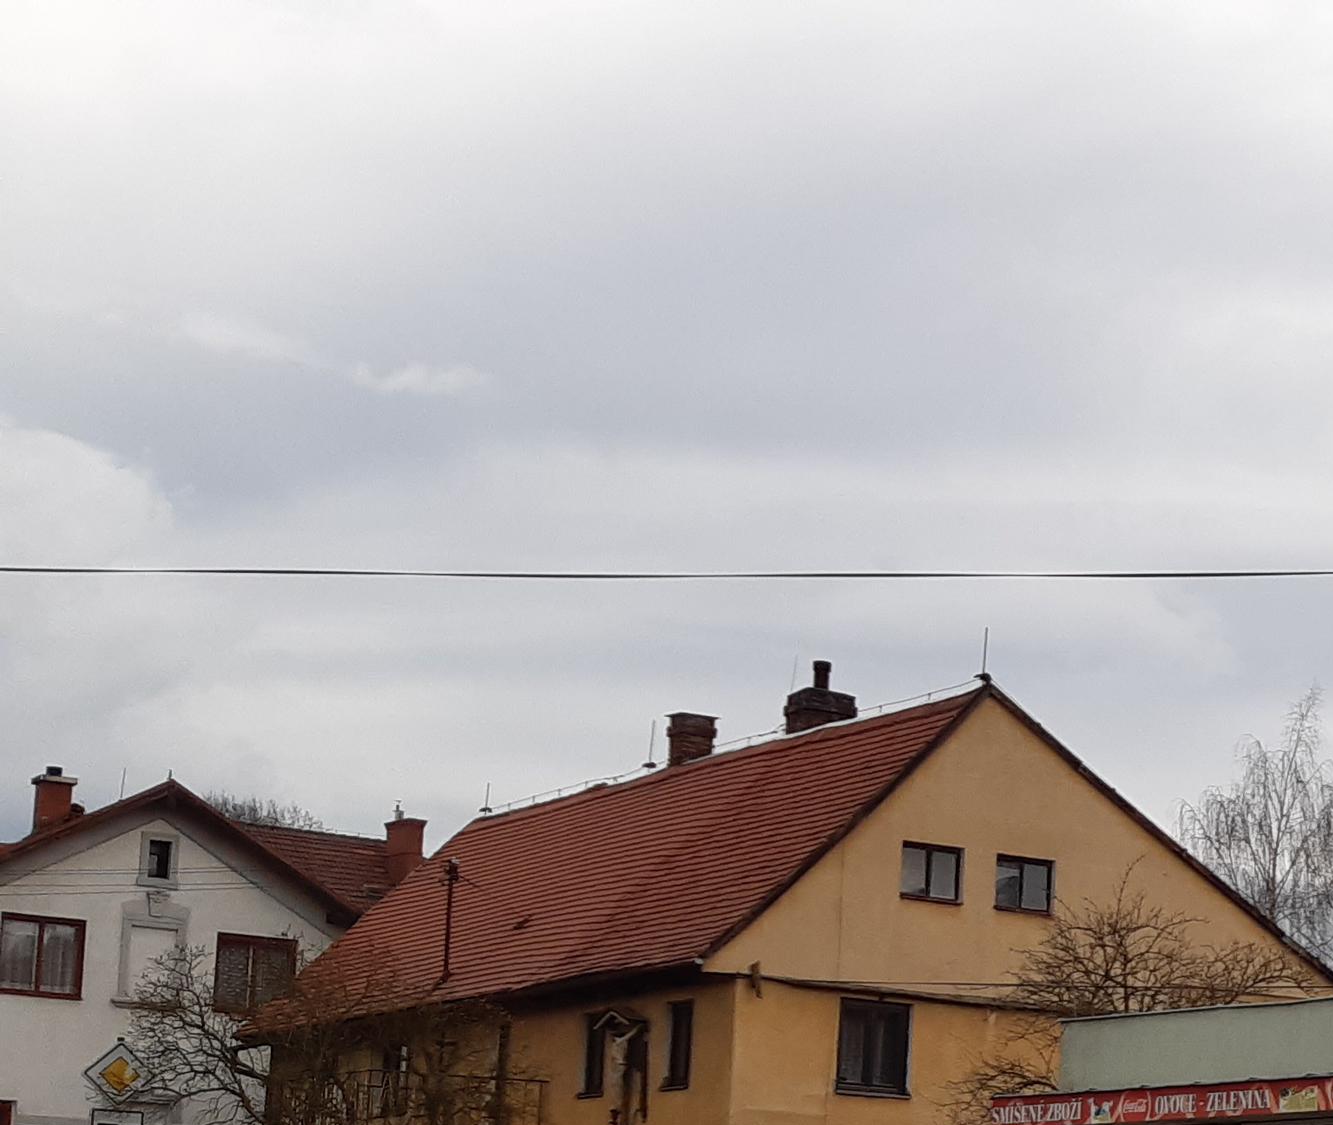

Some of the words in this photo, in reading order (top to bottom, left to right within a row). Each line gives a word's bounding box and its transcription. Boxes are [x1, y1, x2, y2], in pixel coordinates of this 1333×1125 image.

[991, 1100, 1045, 1125] SMÍŠENÉ
[1046, 1097, 1083, 1121] ZBOŽÍ
[1155, 1093, 1197, 1115] OVOCE
[1206, 1089, 1271, 1112] ZELENINA
